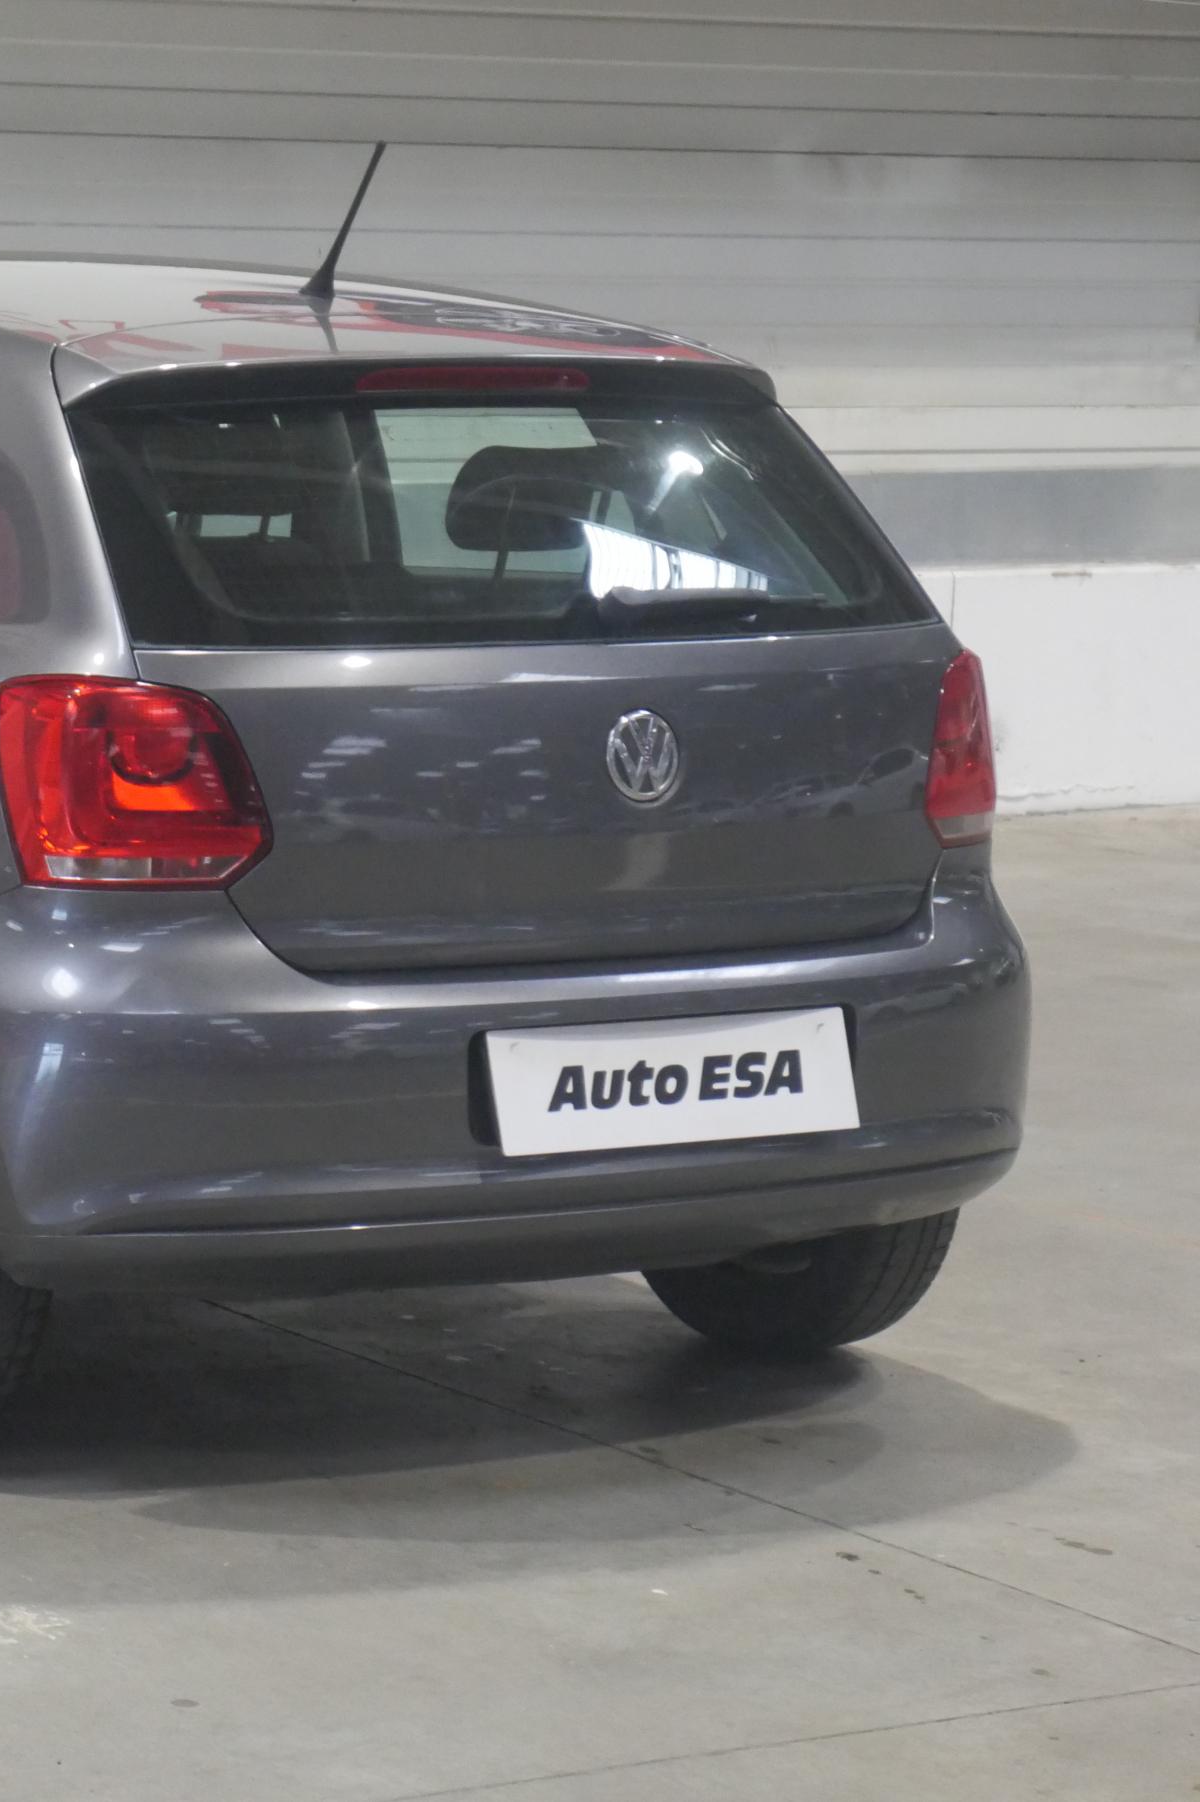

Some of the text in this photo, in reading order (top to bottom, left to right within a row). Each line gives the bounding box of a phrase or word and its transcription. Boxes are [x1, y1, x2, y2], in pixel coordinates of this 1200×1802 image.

[609, 713, 676, 797] VW
[548, 1049, 803, 1112] Auto ESA
